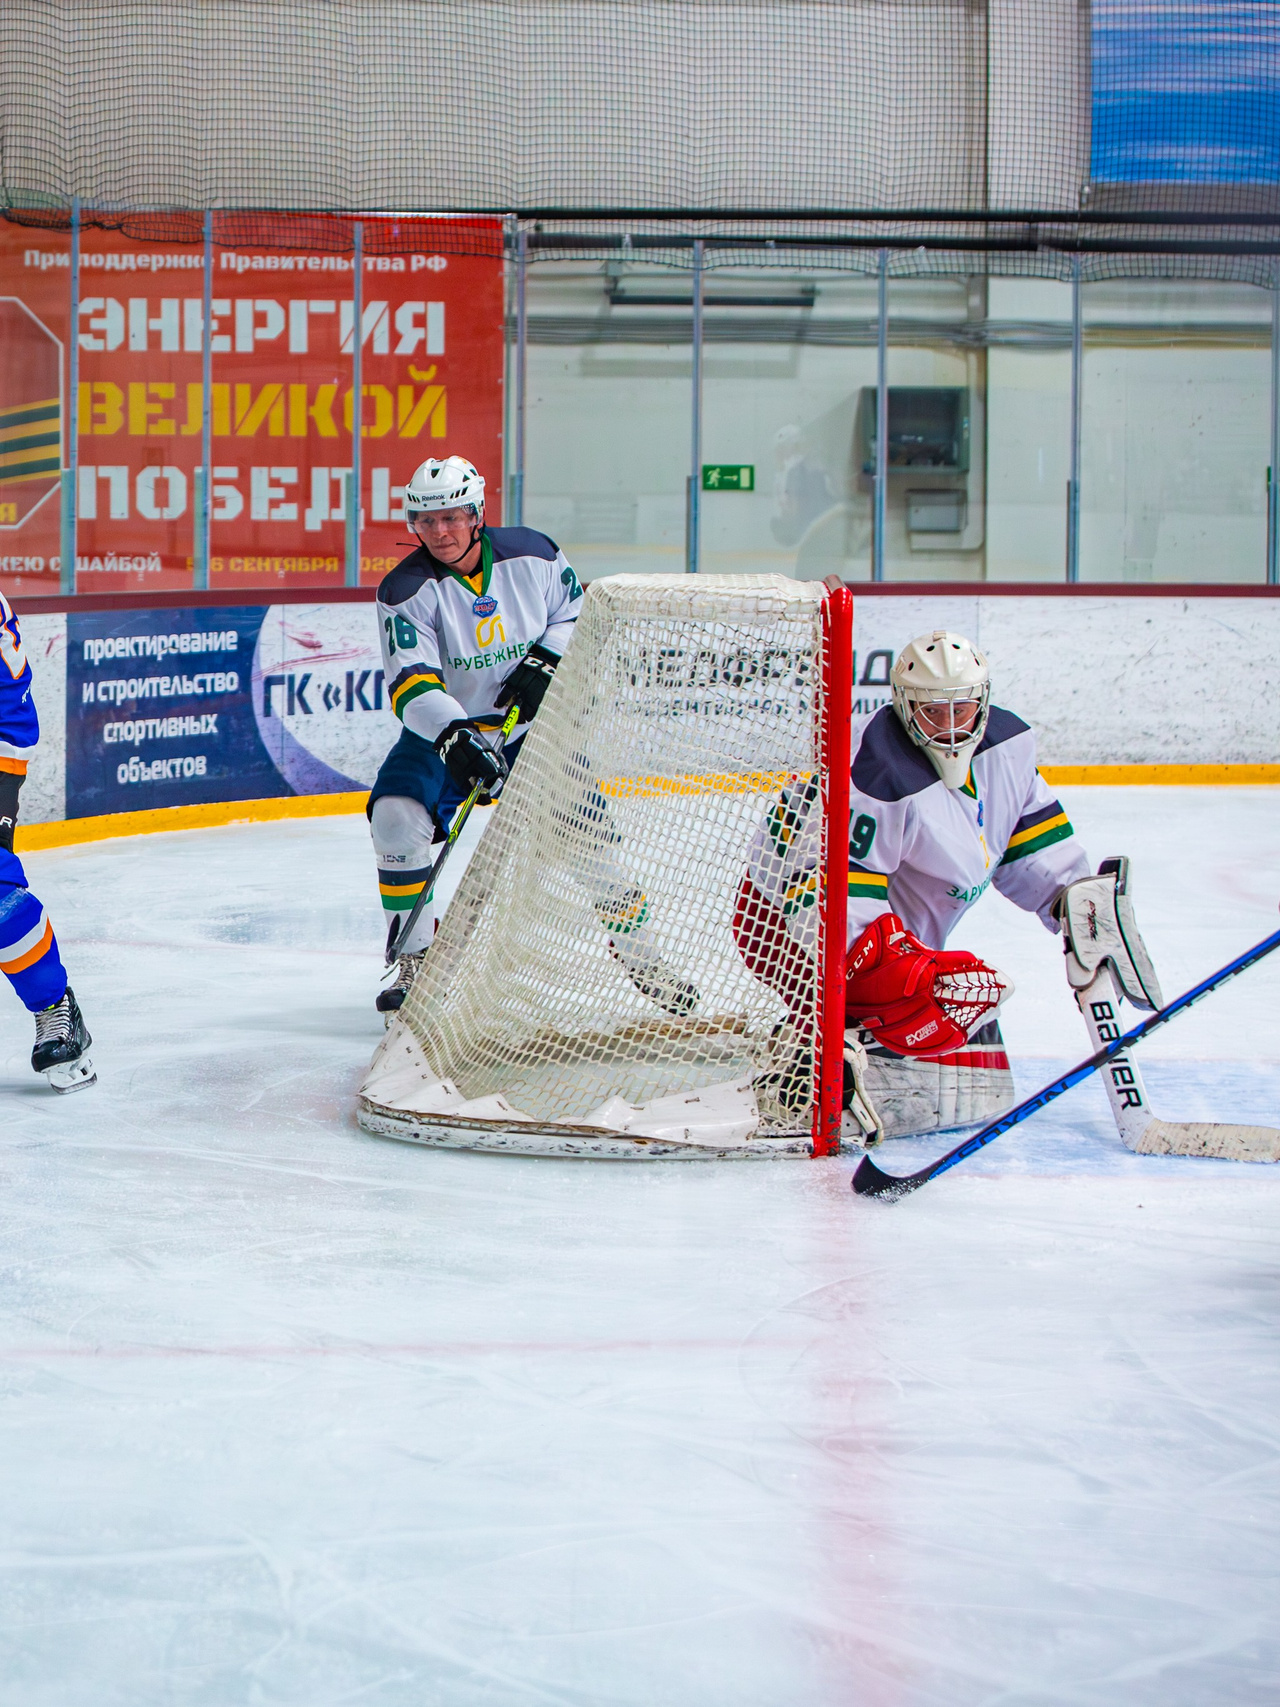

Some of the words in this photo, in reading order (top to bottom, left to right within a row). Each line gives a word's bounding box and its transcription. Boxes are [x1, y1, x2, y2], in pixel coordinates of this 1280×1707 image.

[24, 250, 70, 270] При
[220, 253, 405, 273] Правительтва
[410, 254, 448, 272] РФ
[78, 297, 446, 355] ЭНЕРГИЯ
[78, 364, 447, 438] ВЕЛИКОЙ
[421, 494, 446, 502] Reebok
[229, 557, 339, 572] СЕНТЯБРЯ
[360, 557, 399, 572] 026
[83, 630, 239, 666] проектирование
[384, 614, 418, 657] 26
[82, 681, 95, 703] и
[96, 671, 239, 705] строительство
[263, 673, 314, 717] ГК
[103, 713, 219, 745] спортивных
[117, 755, 208, 784] объектов
[850, 809, 877, 860] 9
[845, 939, 874, 981] CCM
